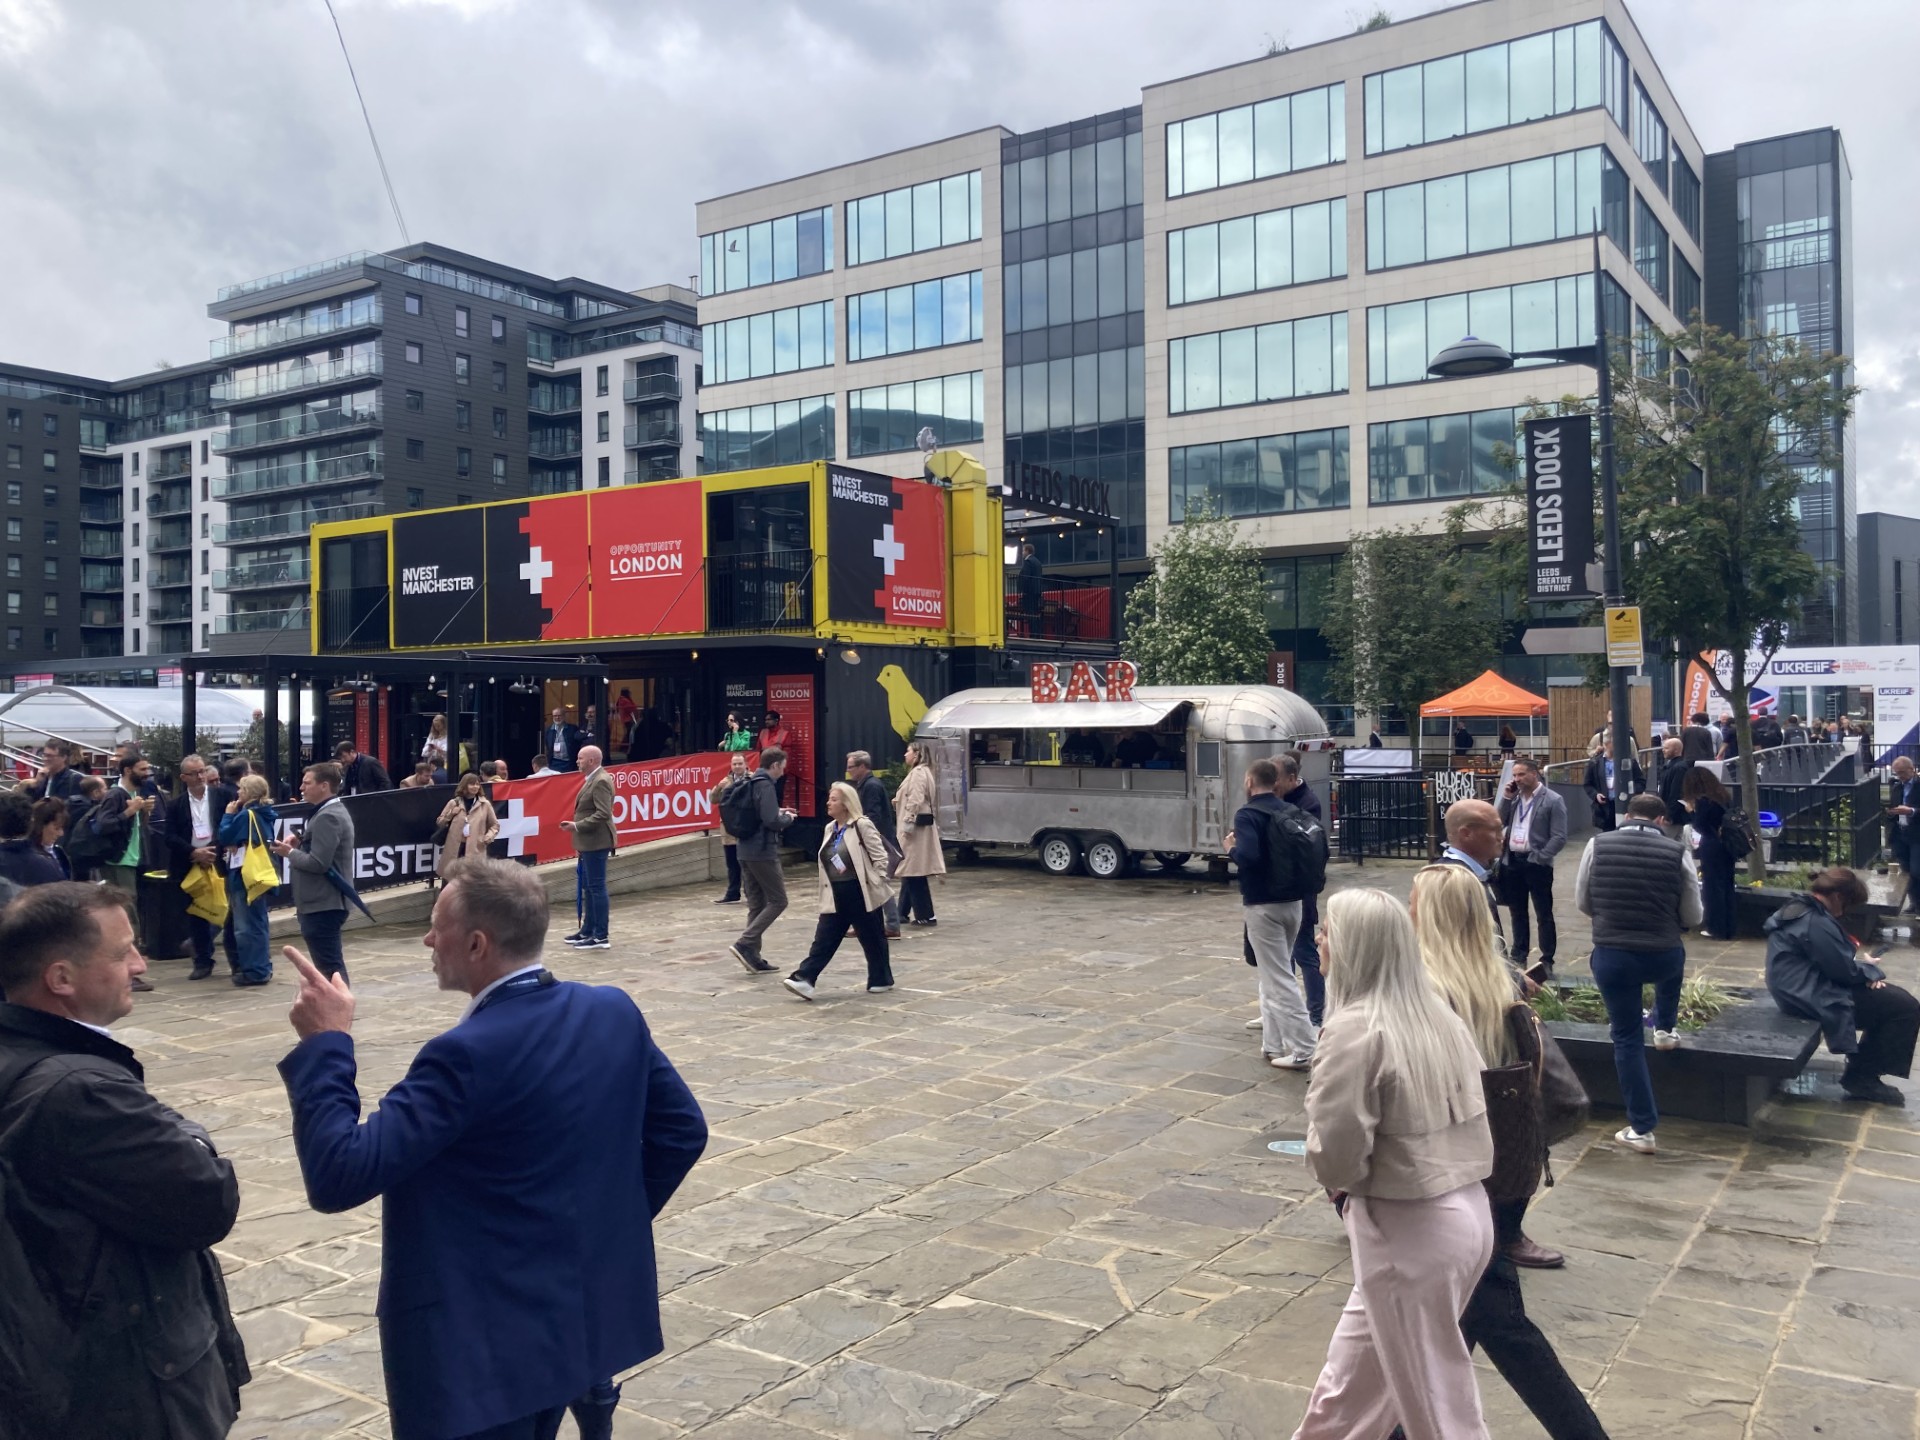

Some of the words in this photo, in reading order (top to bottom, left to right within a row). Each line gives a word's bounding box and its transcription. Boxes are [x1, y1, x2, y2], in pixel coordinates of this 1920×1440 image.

[1533, 427, 1562, 490] DOCK
[832, 486, 888, 507] MANCHESTER
[1011, 460, 1063, 508] LEEDS
[1069, 474, 1111, 517] DOCK
[1535, 494, 1564, 563] LEEDS
[609, 540, 682, 556] OPPORTUNITY
[610, 553, 682, 575] LONDON
[1537, 568, 1560, 577] LEEDS
[402, 577, 474, 595] MANCHESTER
[1537, 576, 1572, 585] CREATIVE
[1537, 584, 1571, 592] DISTRICT
[892, 585, 941, 598] OPPORTUNITY
[893, 597, 941, 614] LONDON
[1031, 661, 1138, 703] BAR
[1276, 662, 1285, 684] DOCK
[770, 689, 810, 699] LONDON
[608, 767, 711, 789] PORTUNITY
[1435, 771, 1475, 788] HOLDFAST
[1436, 788, 1477, 803] BOOKSHOP
[612, 789, 712, 824] ONDON
